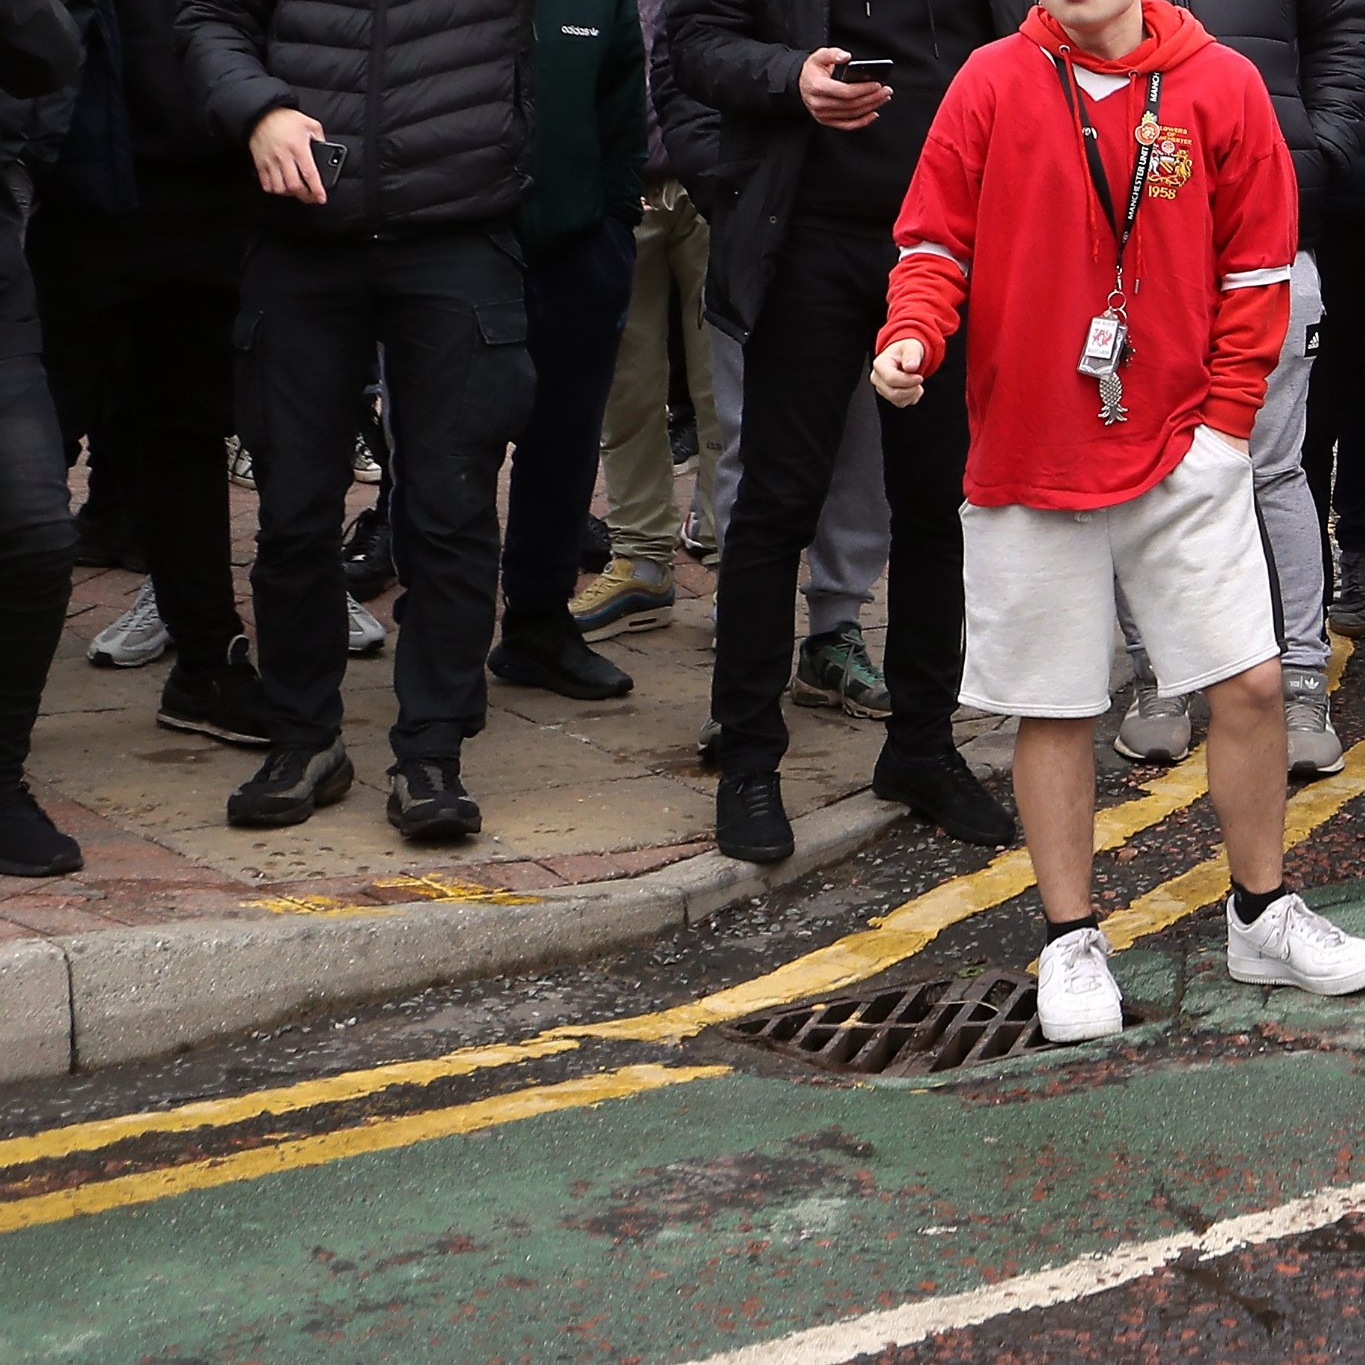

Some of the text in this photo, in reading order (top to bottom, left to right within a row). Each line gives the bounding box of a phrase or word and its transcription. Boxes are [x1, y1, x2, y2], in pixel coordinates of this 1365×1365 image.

[1150, 72, 1160, 102] MANCH
[1159, 125, 1188, 134] LOWERS
[1128, 146, 1149, 220] MANCHESTER UNIT
[1148, 185, 1177, 200] 1958
